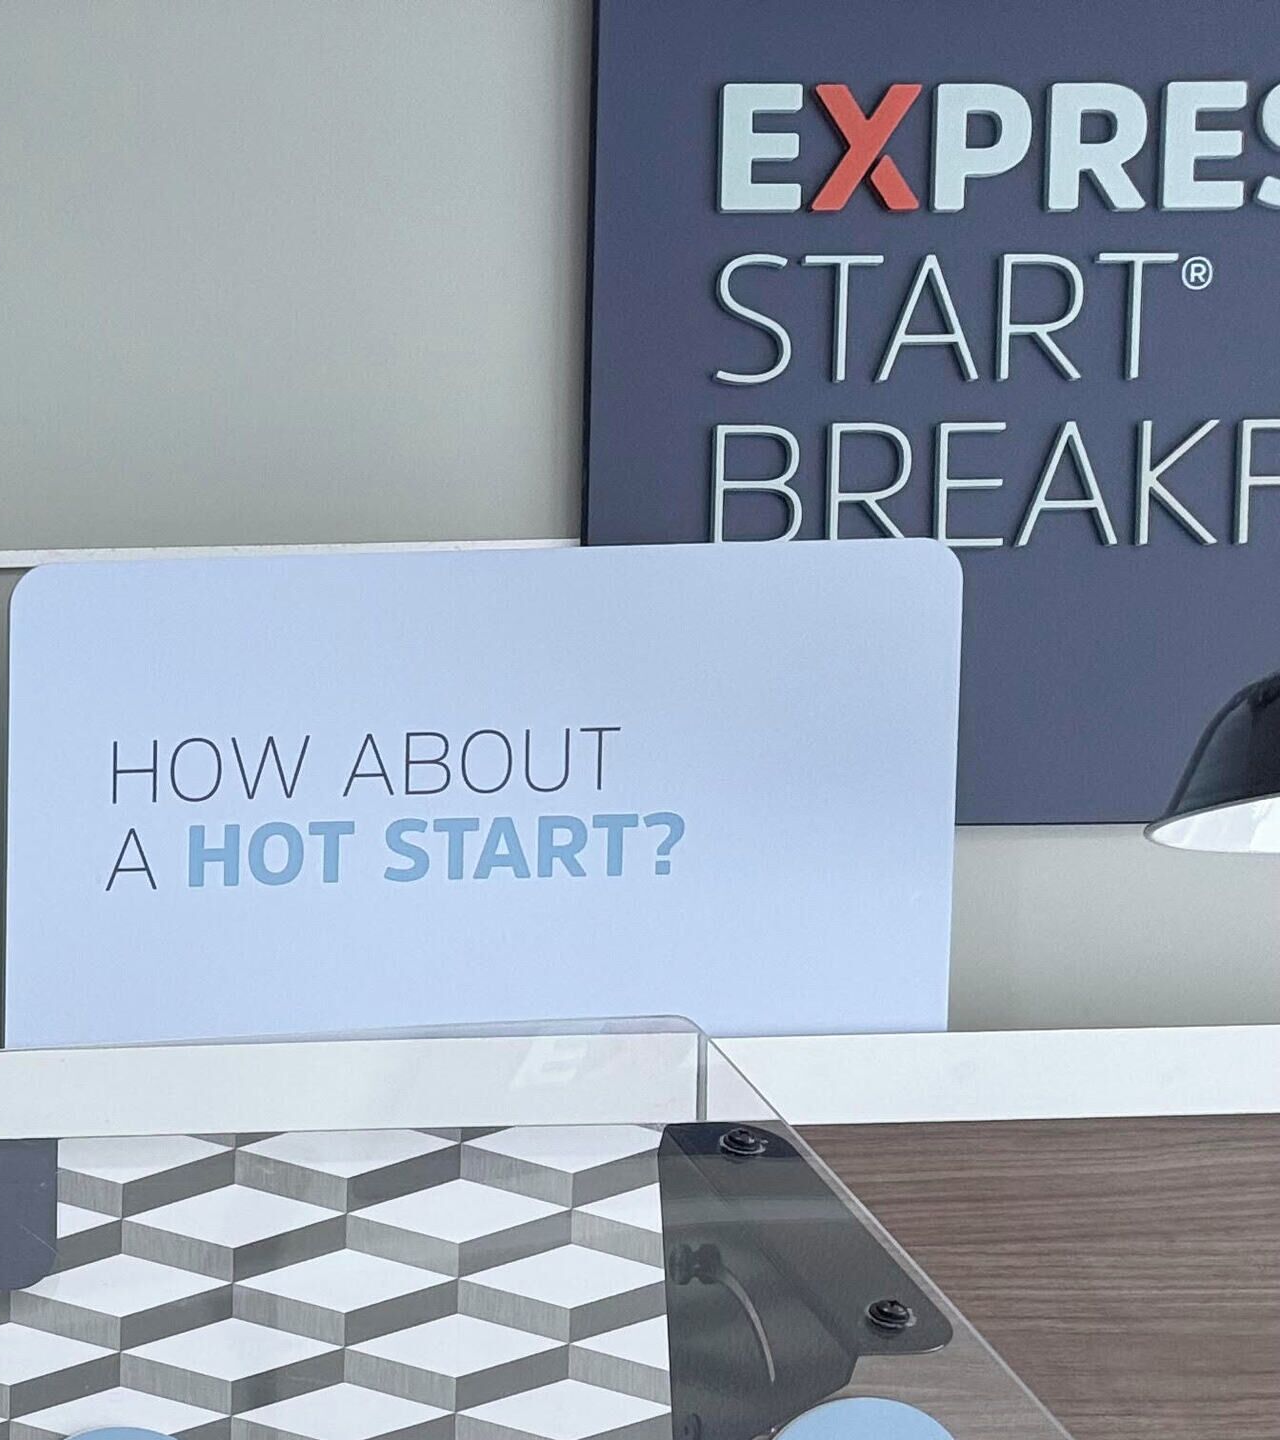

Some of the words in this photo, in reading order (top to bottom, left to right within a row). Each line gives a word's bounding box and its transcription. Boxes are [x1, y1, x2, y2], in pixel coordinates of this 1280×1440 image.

[111, 735, 310, 804] HOW
[343, 727, 621, 797] ABOUT
[105, 828, 157, 892] A
[187, 821, 355, 888] HOT
[383, 812, 686, 883] START?
